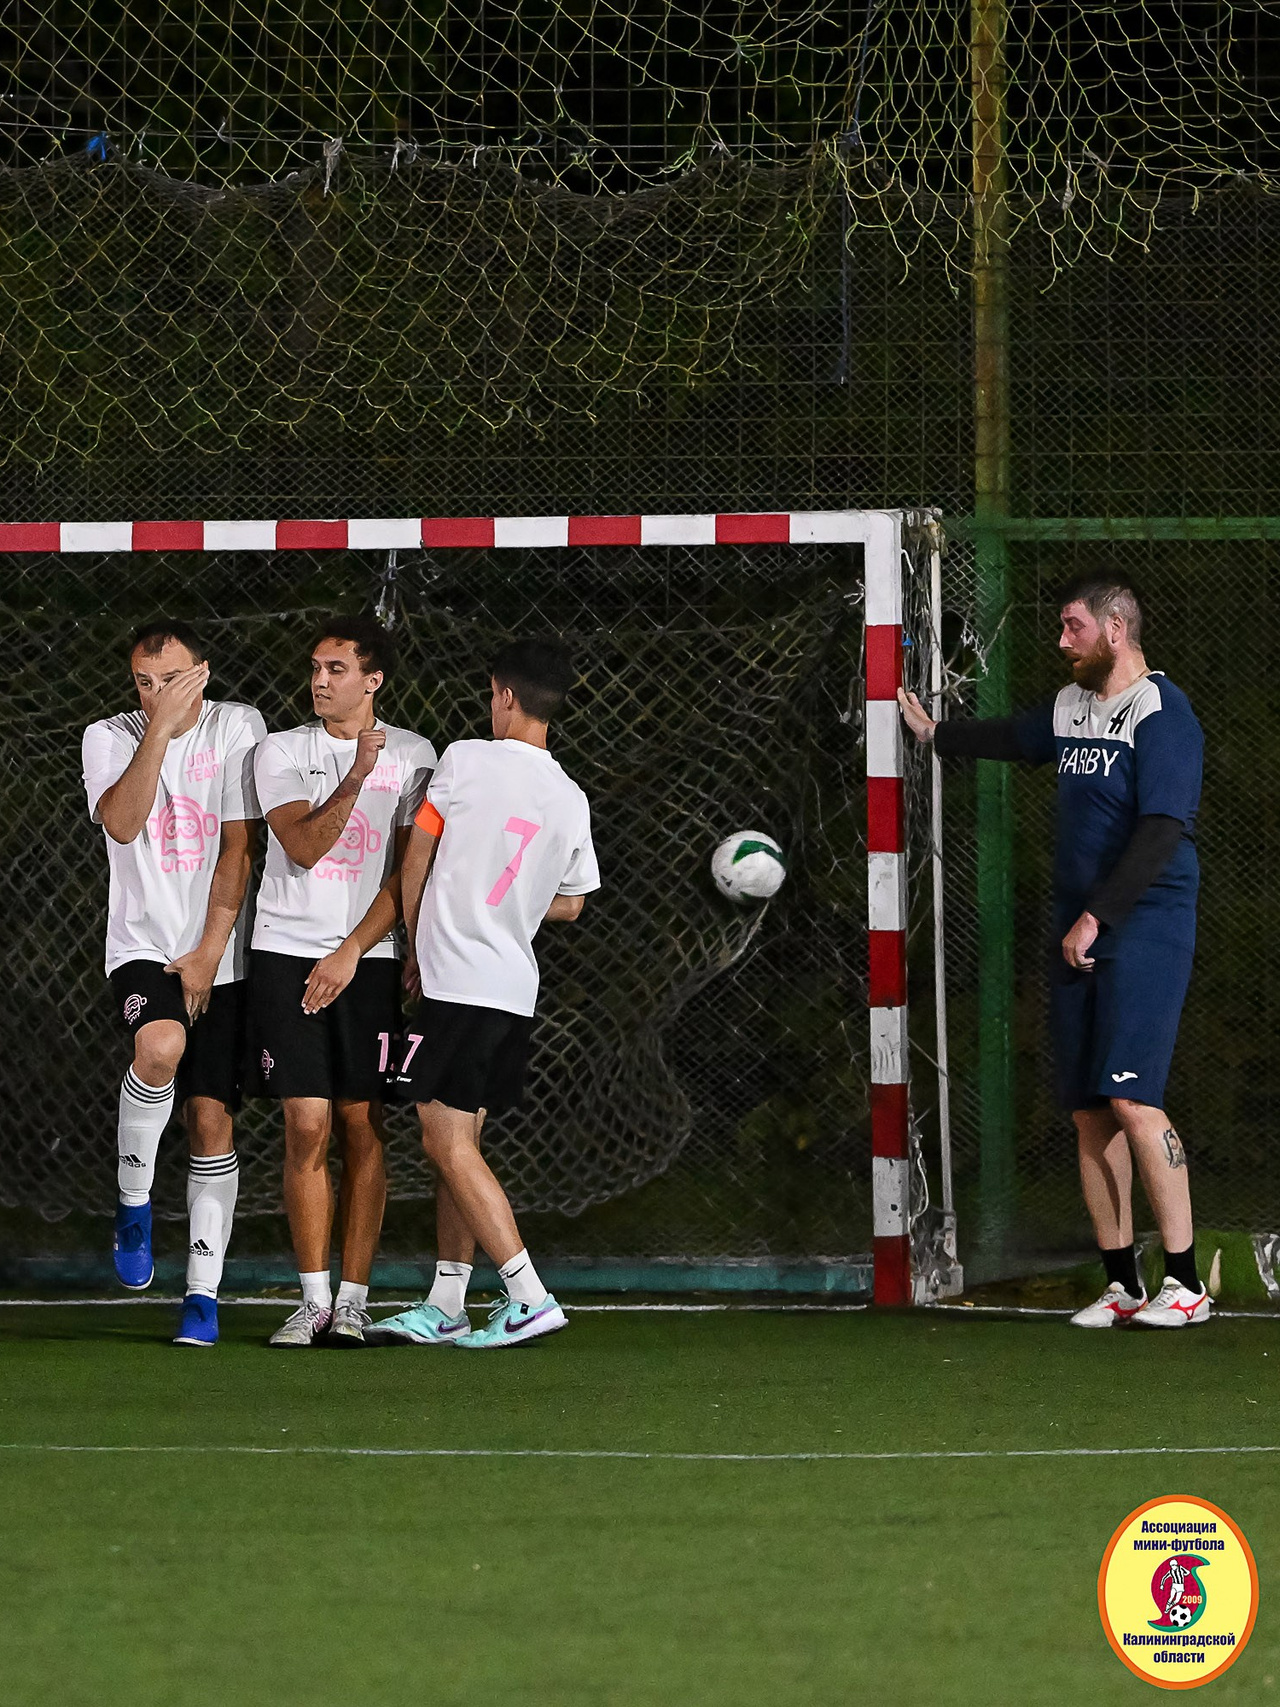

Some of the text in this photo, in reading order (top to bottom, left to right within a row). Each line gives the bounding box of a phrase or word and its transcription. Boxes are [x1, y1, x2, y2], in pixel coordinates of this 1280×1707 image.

[187, 748, 216, 768] UNIT
[1058, 747, 1120, 777] FARBY
[374, 765, 398, 778] NIT
[161, 857, 205, 873] UNIT
[485, 816, 542, 907] 7
[314, 866, 363, 883] UNIT
